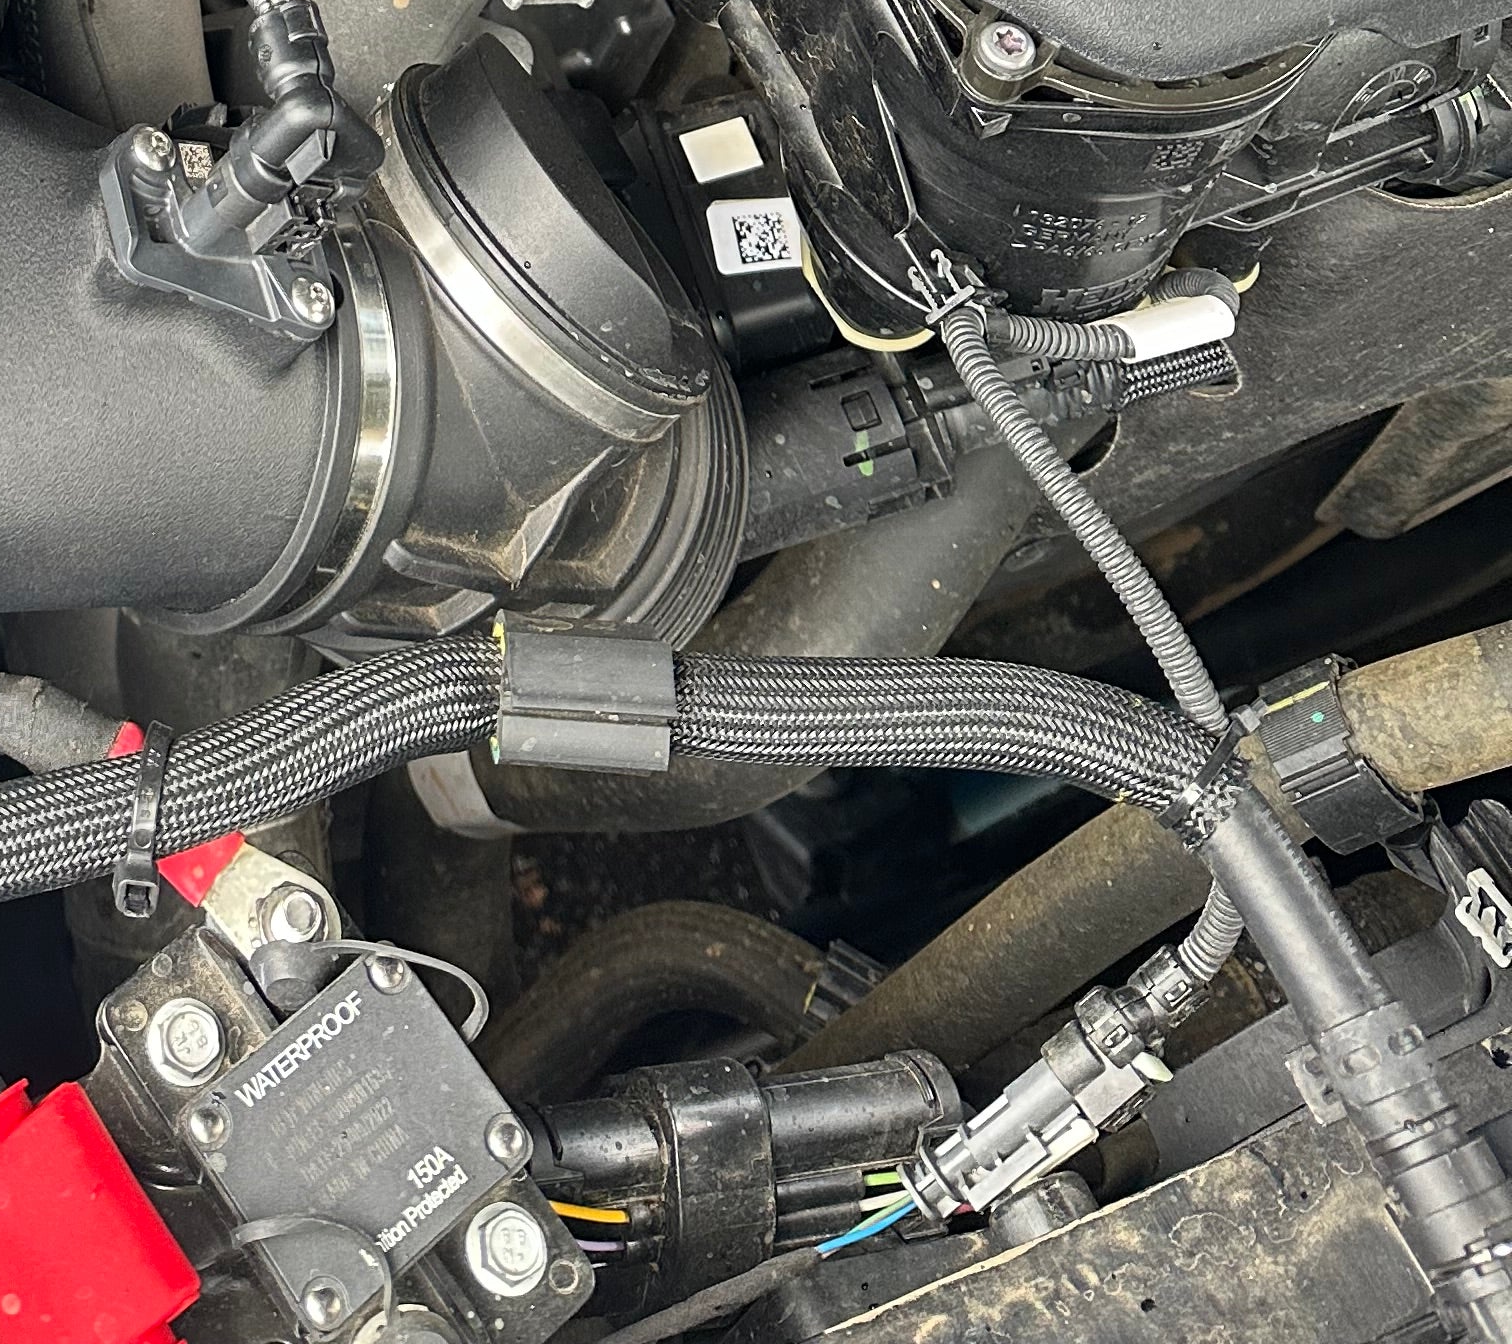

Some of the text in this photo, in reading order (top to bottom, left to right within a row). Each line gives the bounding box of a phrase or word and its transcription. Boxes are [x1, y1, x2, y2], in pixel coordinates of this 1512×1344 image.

[233, 989, 363, 1108] WATERPROOF
[400, 1163, 470, 1229] Protected
[406, 1145, 456, 1189] 150A
